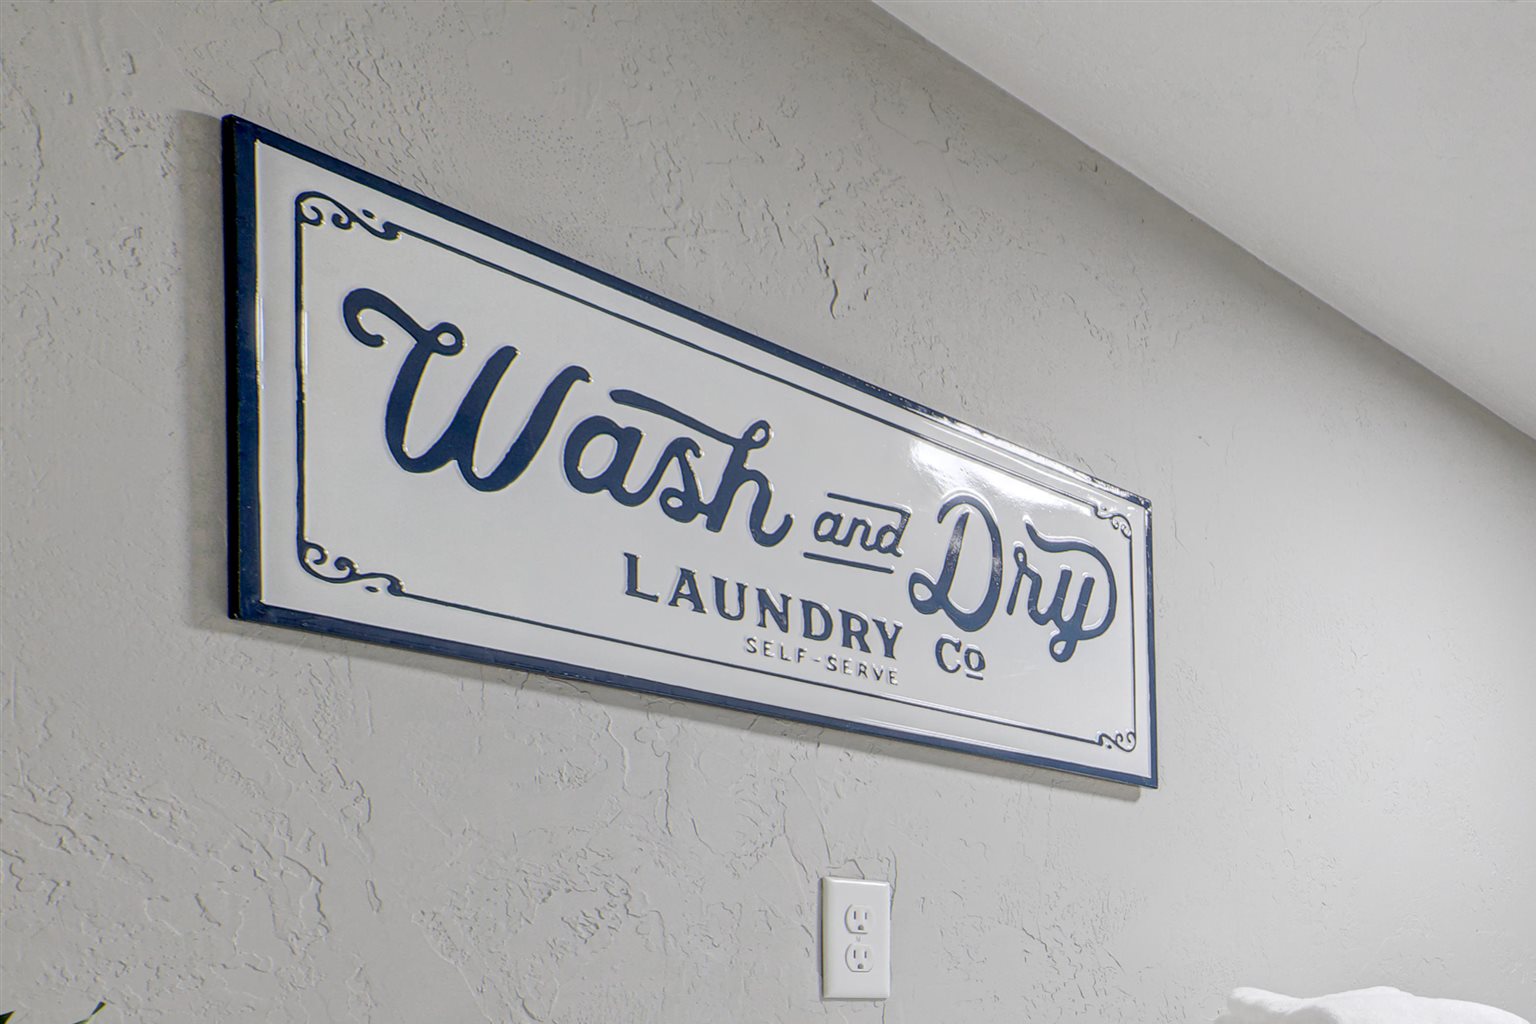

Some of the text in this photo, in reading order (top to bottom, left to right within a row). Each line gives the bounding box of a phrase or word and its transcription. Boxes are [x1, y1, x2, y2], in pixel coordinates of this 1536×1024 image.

[342, 287, 1117, 663] Wash and Dry
[624, 552, 903, 661] LAUNDRY
[745, 636, 898, 686] SELF-SERVE
